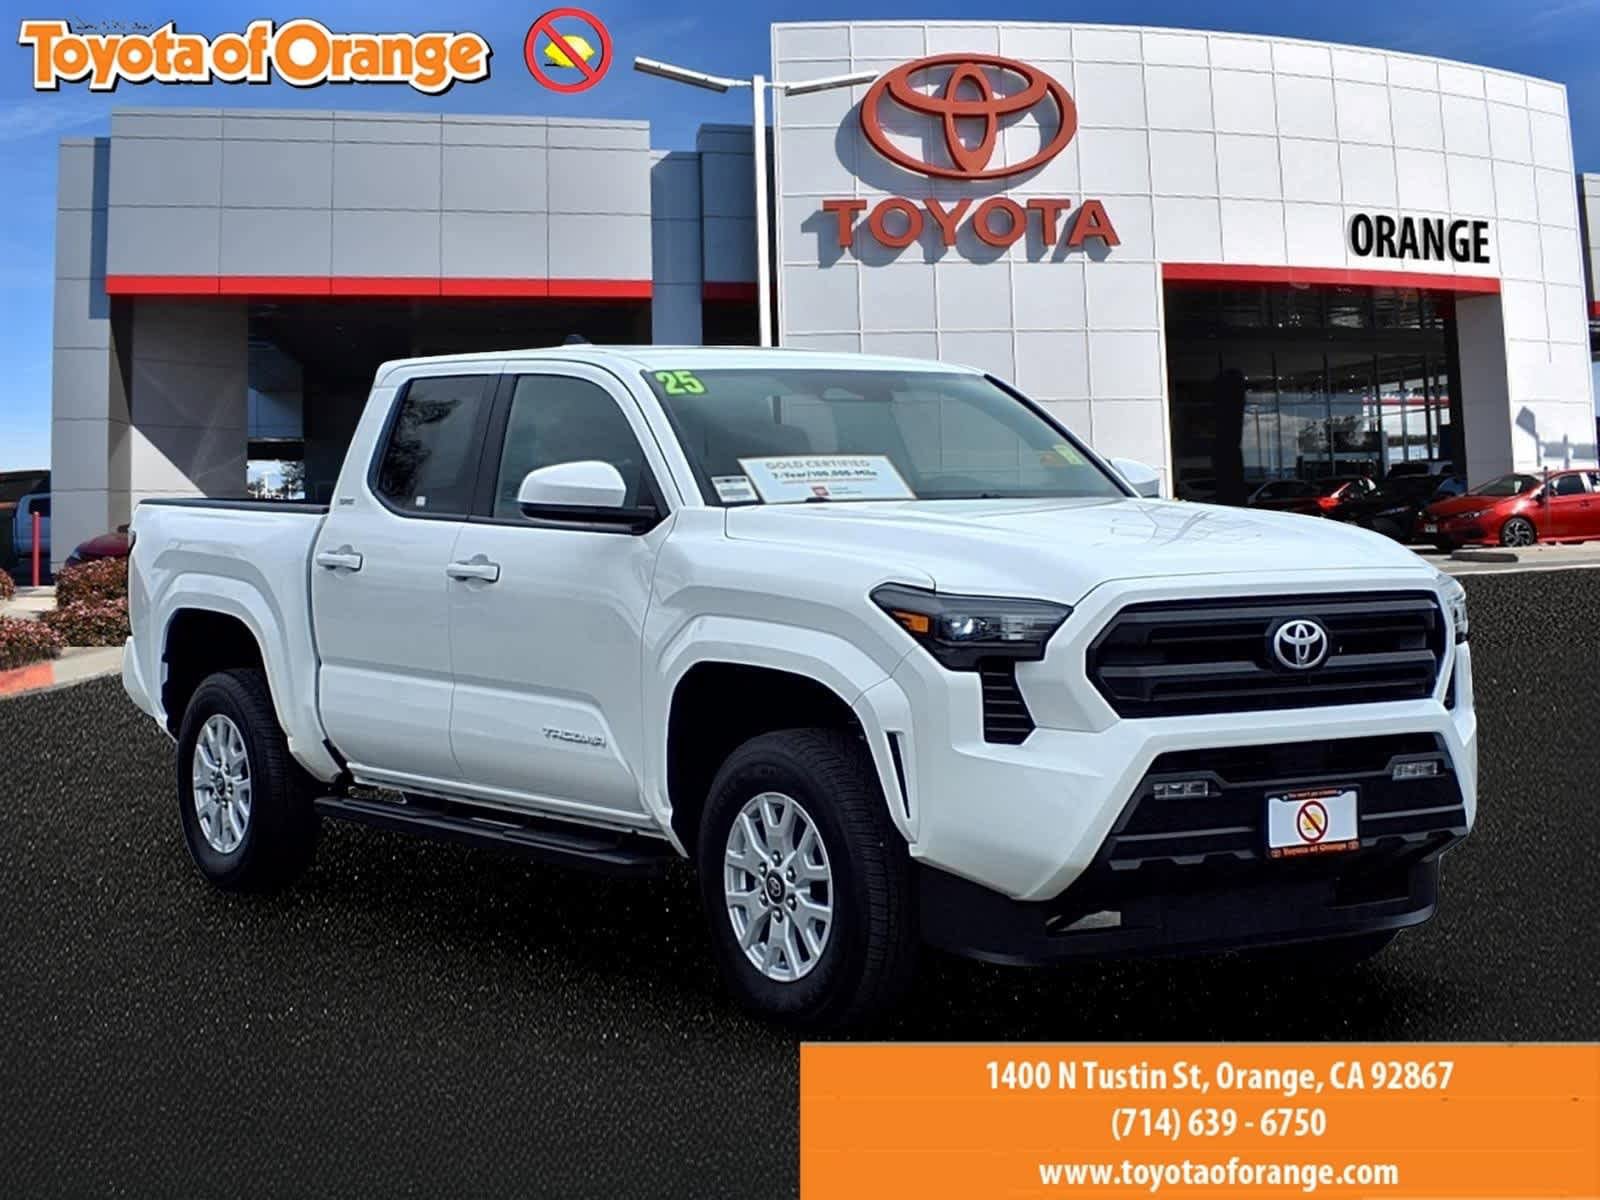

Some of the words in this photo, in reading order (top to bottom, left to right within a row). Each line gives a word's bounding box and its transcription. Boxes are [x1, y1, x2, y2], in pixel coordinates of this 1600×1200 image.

[822, 197, 1121, 248] TOYOTA
[1349, 213, 1491, 264] ORANGE
[655, 370, 706, 395] 25
[542, 727, 607, 748] TACOMA
